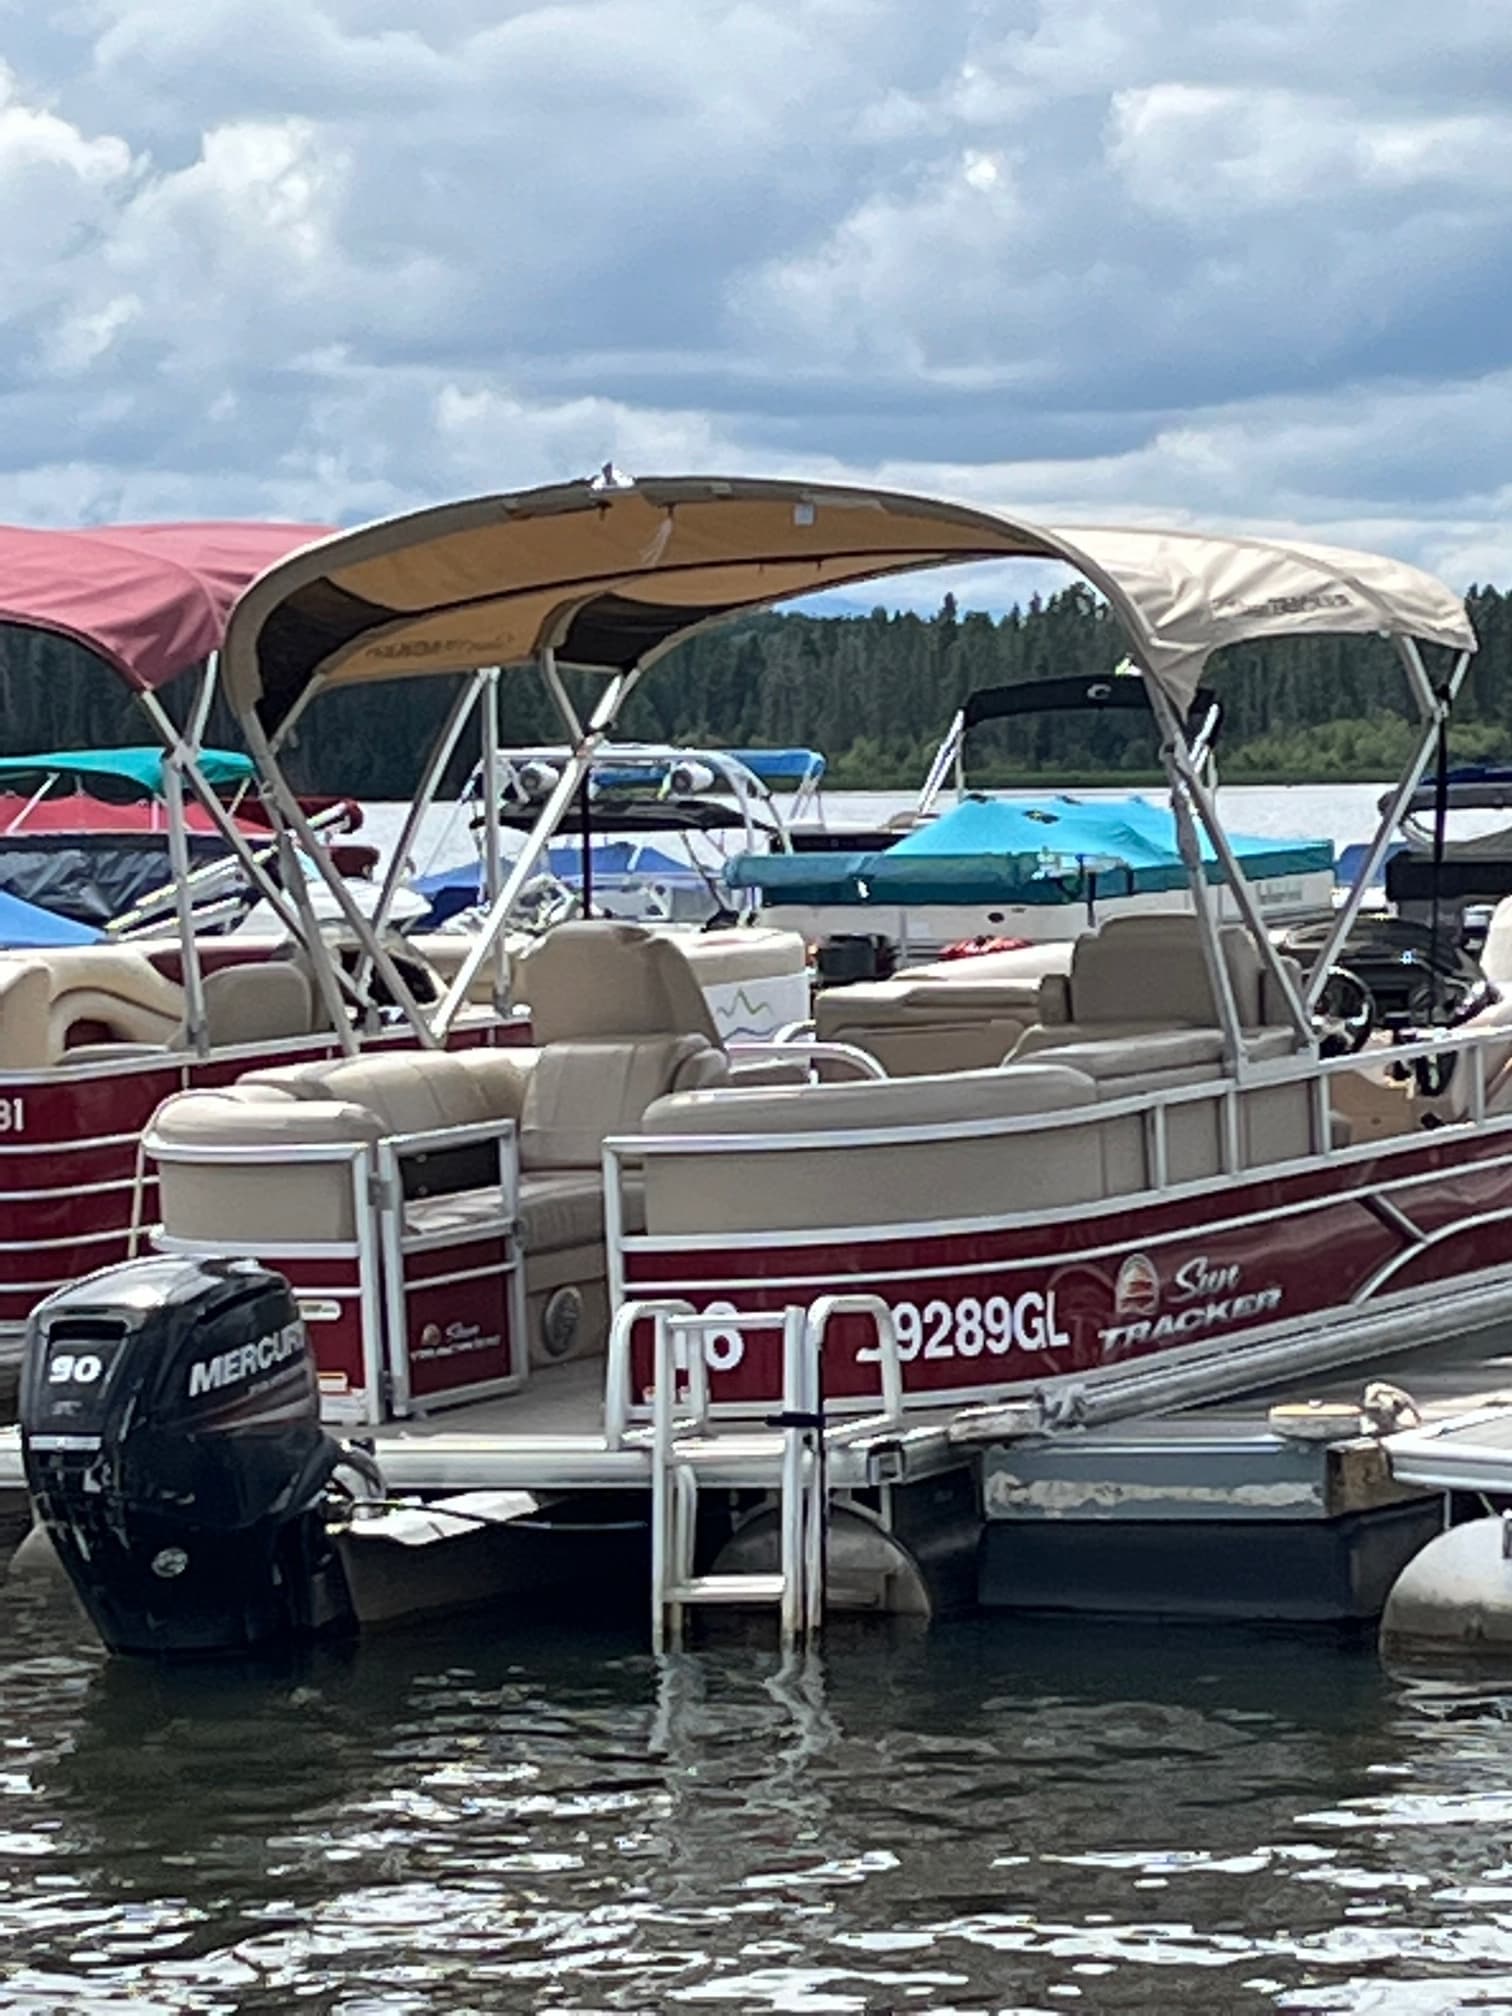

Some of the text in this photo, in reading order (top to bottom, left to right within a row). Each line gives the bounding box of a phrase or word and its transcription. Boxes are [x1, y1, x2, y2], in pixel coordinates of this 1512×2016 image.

[1165, 1256, 1240, 1303] Sun
[1097, 1288, 1283, 1352] TRACKER
[48, 1354, 102, 1383] 90
